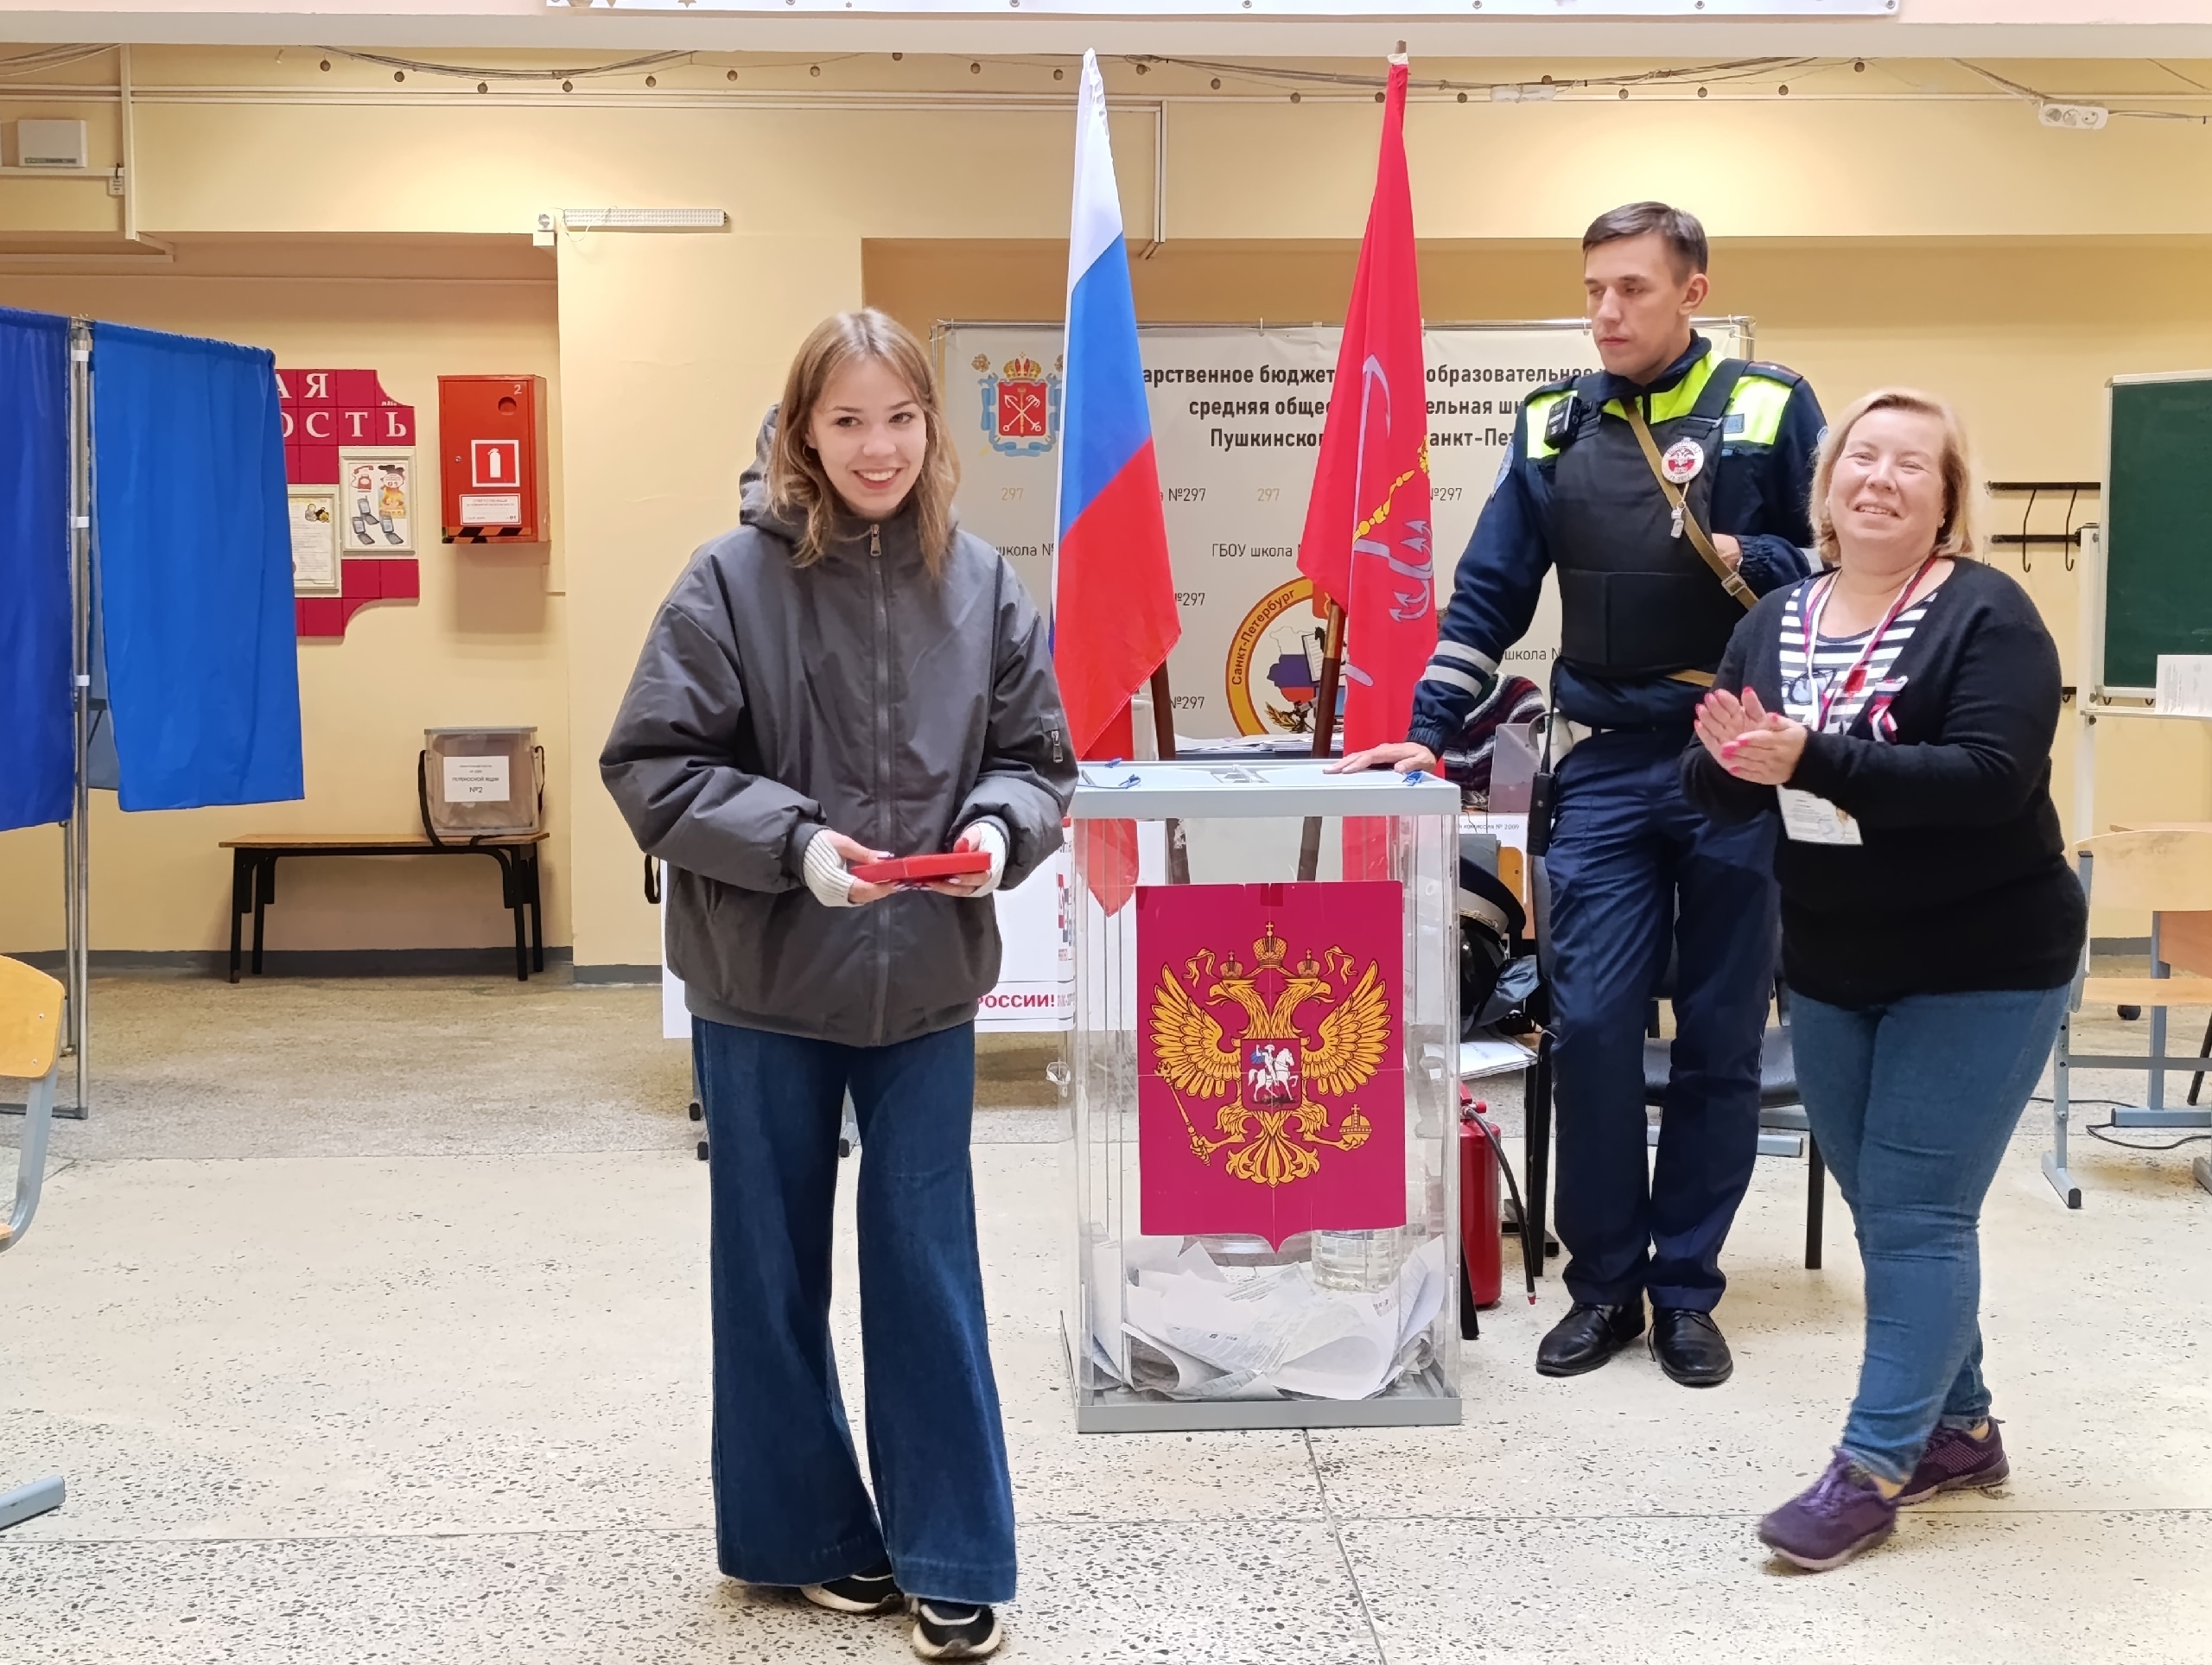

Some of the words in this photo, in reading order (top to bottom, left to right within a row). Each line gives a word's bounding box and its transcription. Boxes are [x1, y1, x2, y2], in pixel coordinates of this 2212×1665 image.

[1142, 368, 1254, 388] арственное
[1260, 364, 1335, 386] бюджет
[513, 384, 523, 395] 2
[1189, 401, 1269, 421] средняя
[1001, 487, 1024, 501] 297
[1167, 487, 1206, 502] №297
[1257, 487, 1280, 502] 297
[1211, 543, 1246, 557] ГБОУ
[1250, 547, 1293, 557] школа
[1231, 588, 1295, 685] Санкт-Петербург
[1504, 650, 1547, 660] школа
